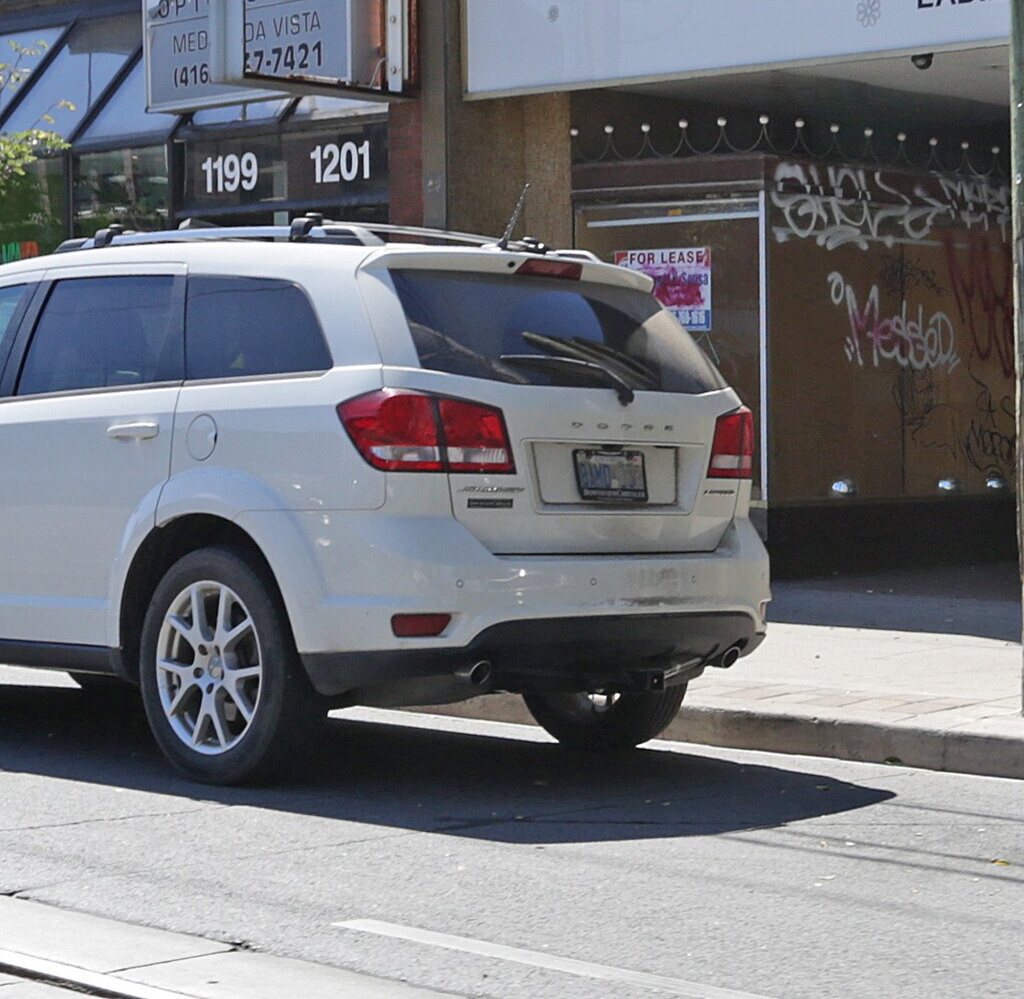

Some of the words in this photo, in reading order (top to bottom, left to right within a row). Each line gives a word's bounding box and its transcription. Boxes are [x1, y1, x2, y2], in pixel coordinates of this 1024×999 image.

[273, 11, 321, 37] VISTA
[174, 64, 208, 88] (416
[202, 152, 258, 193] 1199
[310, 140, 370, 183] 1201
[629, 252, 655, 265] FOR
[661, 250, 704, 264] LEASE
